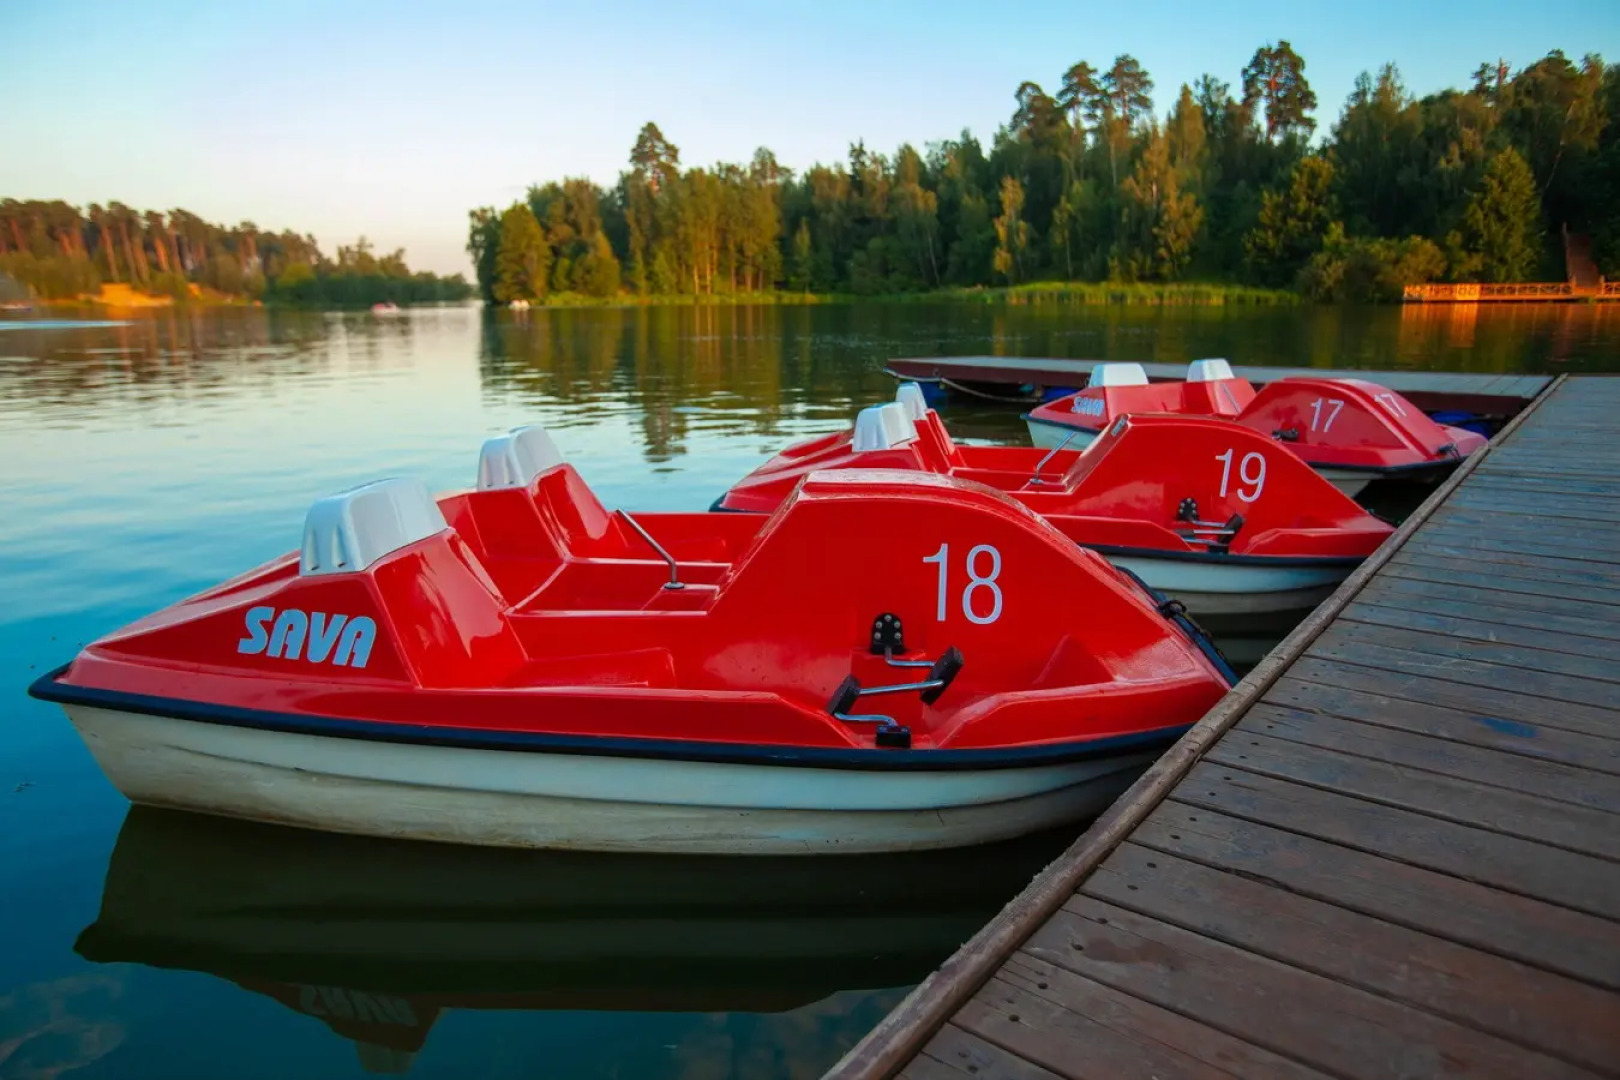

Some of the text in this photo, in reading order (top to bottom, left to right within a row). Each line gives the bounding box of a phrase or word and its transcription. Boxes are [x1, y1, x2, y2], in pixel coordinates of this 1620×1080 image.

[1311, 398, 1344, 432] 17
[1374, 393, 1406, 417] 17
[1215, 448, 1266, 502] 19
[922, 543, 1003, 624] 18
[237, 606, 377, 668] SAVA
